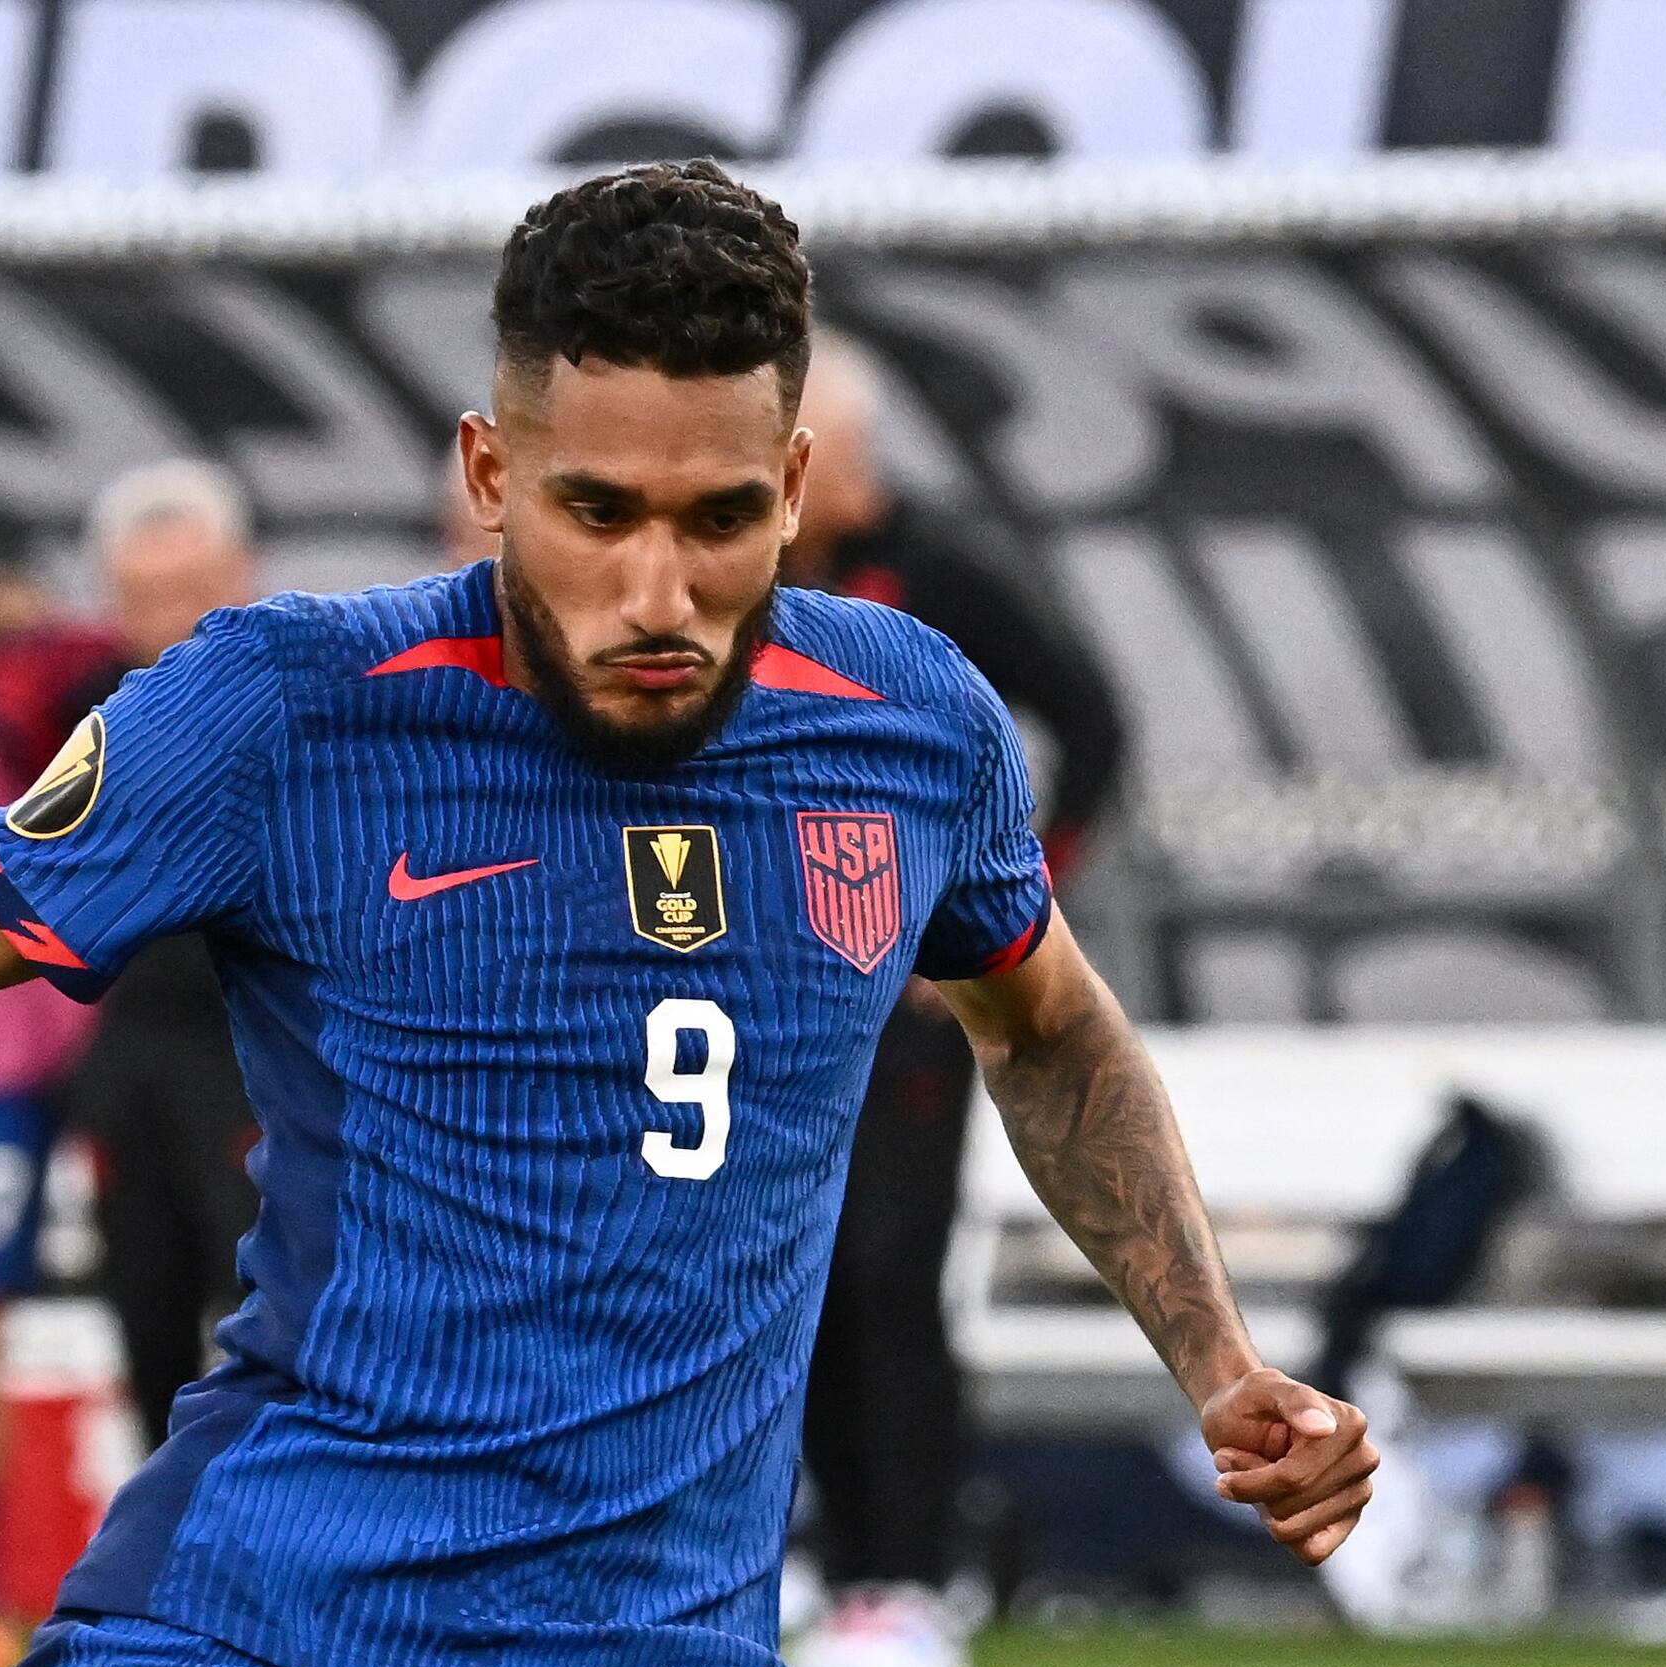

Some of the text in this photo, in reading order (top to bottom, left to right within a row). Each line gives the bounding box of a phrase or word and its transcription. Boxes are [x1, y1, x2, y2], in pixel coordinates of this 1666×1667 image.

[806, 821, 889, 881] USA
[656, 898, 697, 911] GOLD
[663, 911, 694, 923] CUP
[641, 998, 735, 1181] 9
